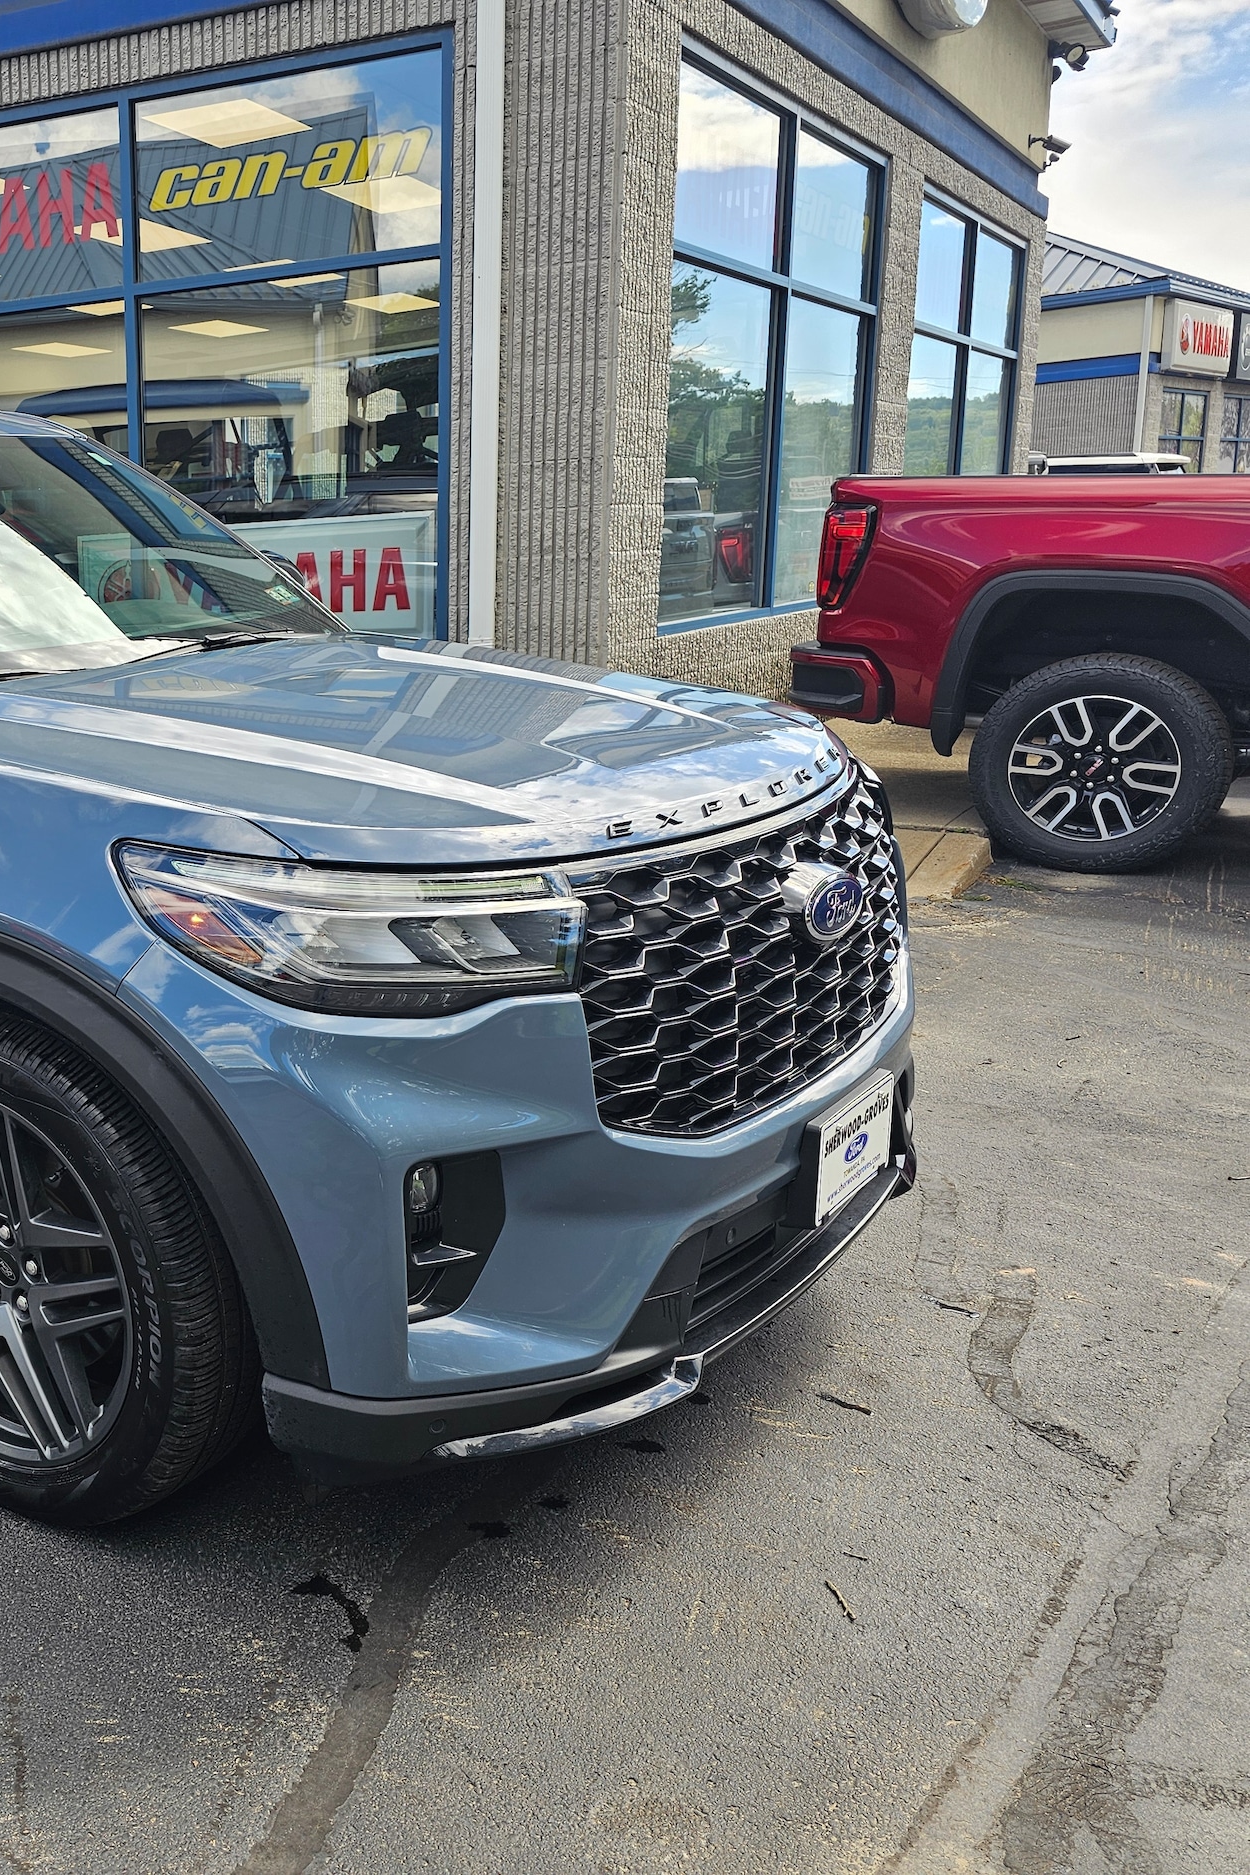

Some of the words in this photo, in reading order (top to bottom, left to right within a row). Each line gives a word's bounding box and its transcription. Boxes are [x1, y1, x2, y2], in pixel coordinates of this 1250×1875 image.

[149, 126, 433, 213] can-am
[1192, 320, 1229, 359] YAMAHA
[606, 746, 841, 841] EXPLORER
[825, 886, 857, 929] Ford
[823, 1091, 890, 1159] SHERWOOD-GROVES
[105, 1190, 163, 1389] SCORPION
